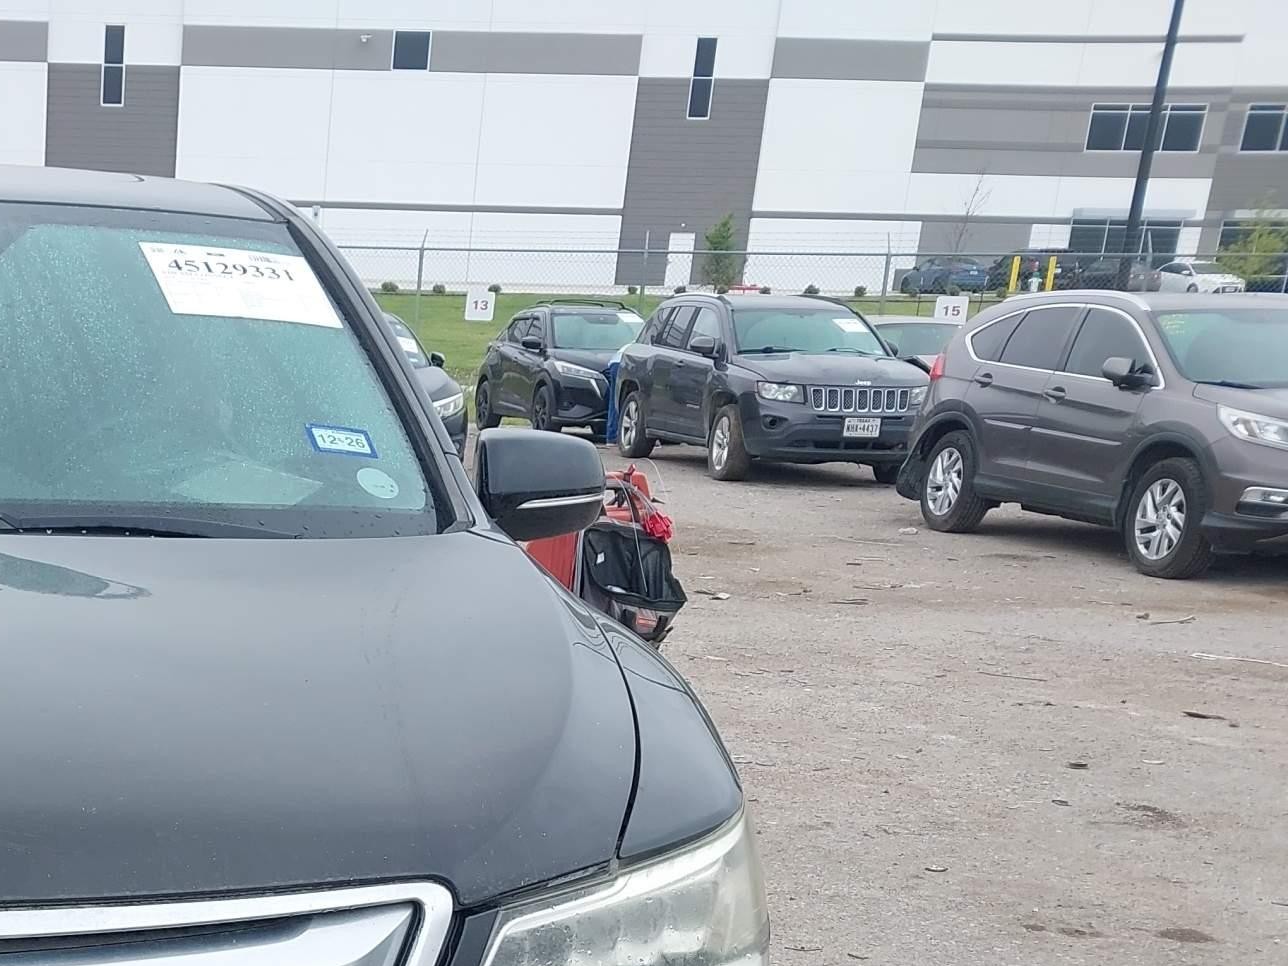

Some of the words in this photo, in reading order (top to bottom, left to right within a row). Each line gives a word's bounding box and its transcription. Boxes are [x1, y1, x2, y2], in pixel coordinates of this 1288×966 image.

[167, 258, 296, 281] 45129331
[473, 300, 489, 311] 13
[943, 305, 961, 317] 15
[318, 433, 365, 449] 12-26
